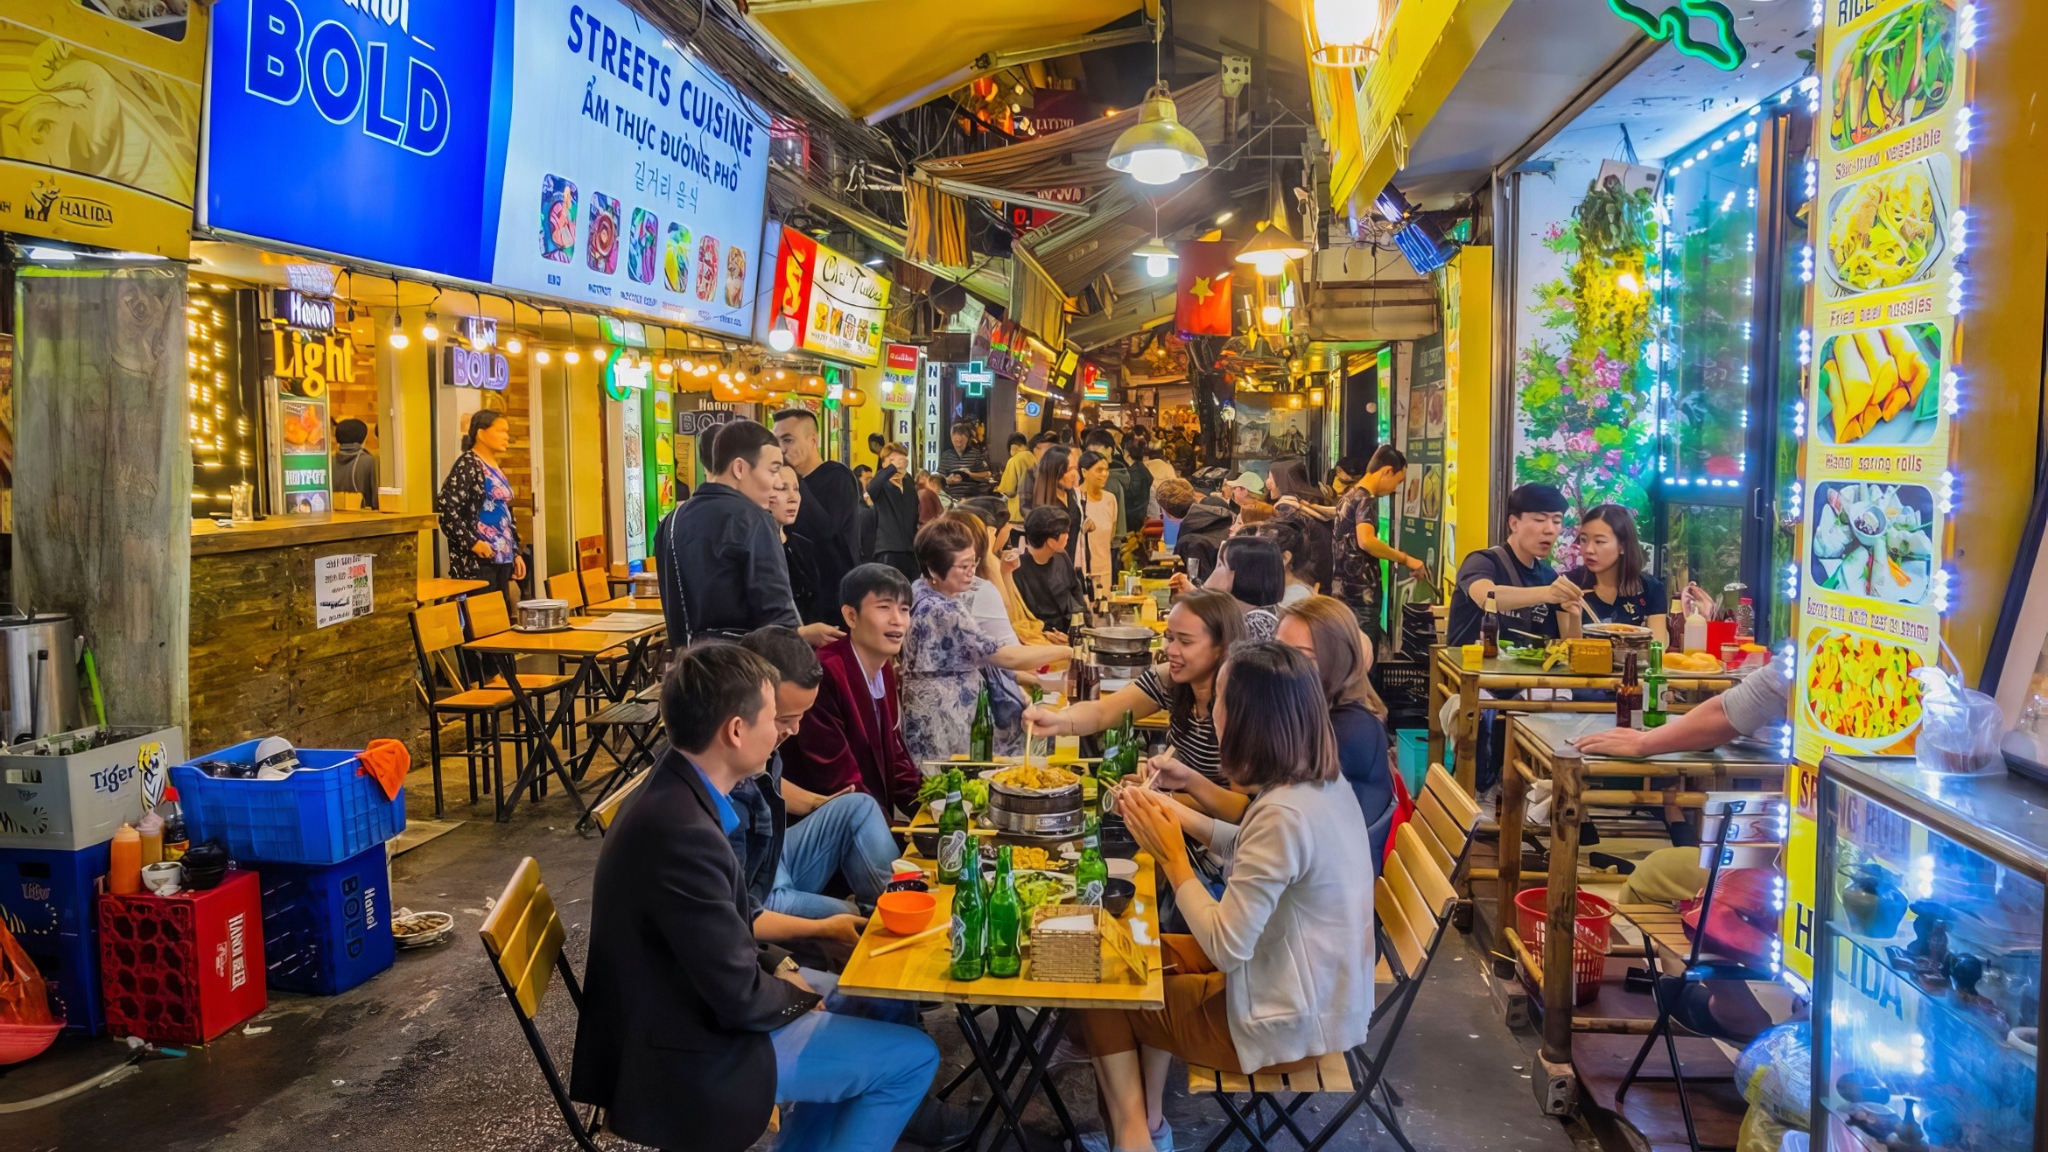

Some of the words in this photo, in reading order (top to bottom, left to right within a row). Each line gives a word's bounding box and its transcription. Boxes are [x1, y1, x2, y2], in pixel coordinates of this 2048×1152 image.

[245, 0, 451, 156] BOLD
[567, 4, 671, 106] STREETS
[679, 79, 754, 158] CUISINE
[272, 328, 357, 399] Light
[453, 345, 510, 391] BOLD
[90, 764, 136, 793] Tiger
[341, 875, 363, 959] BOLD
